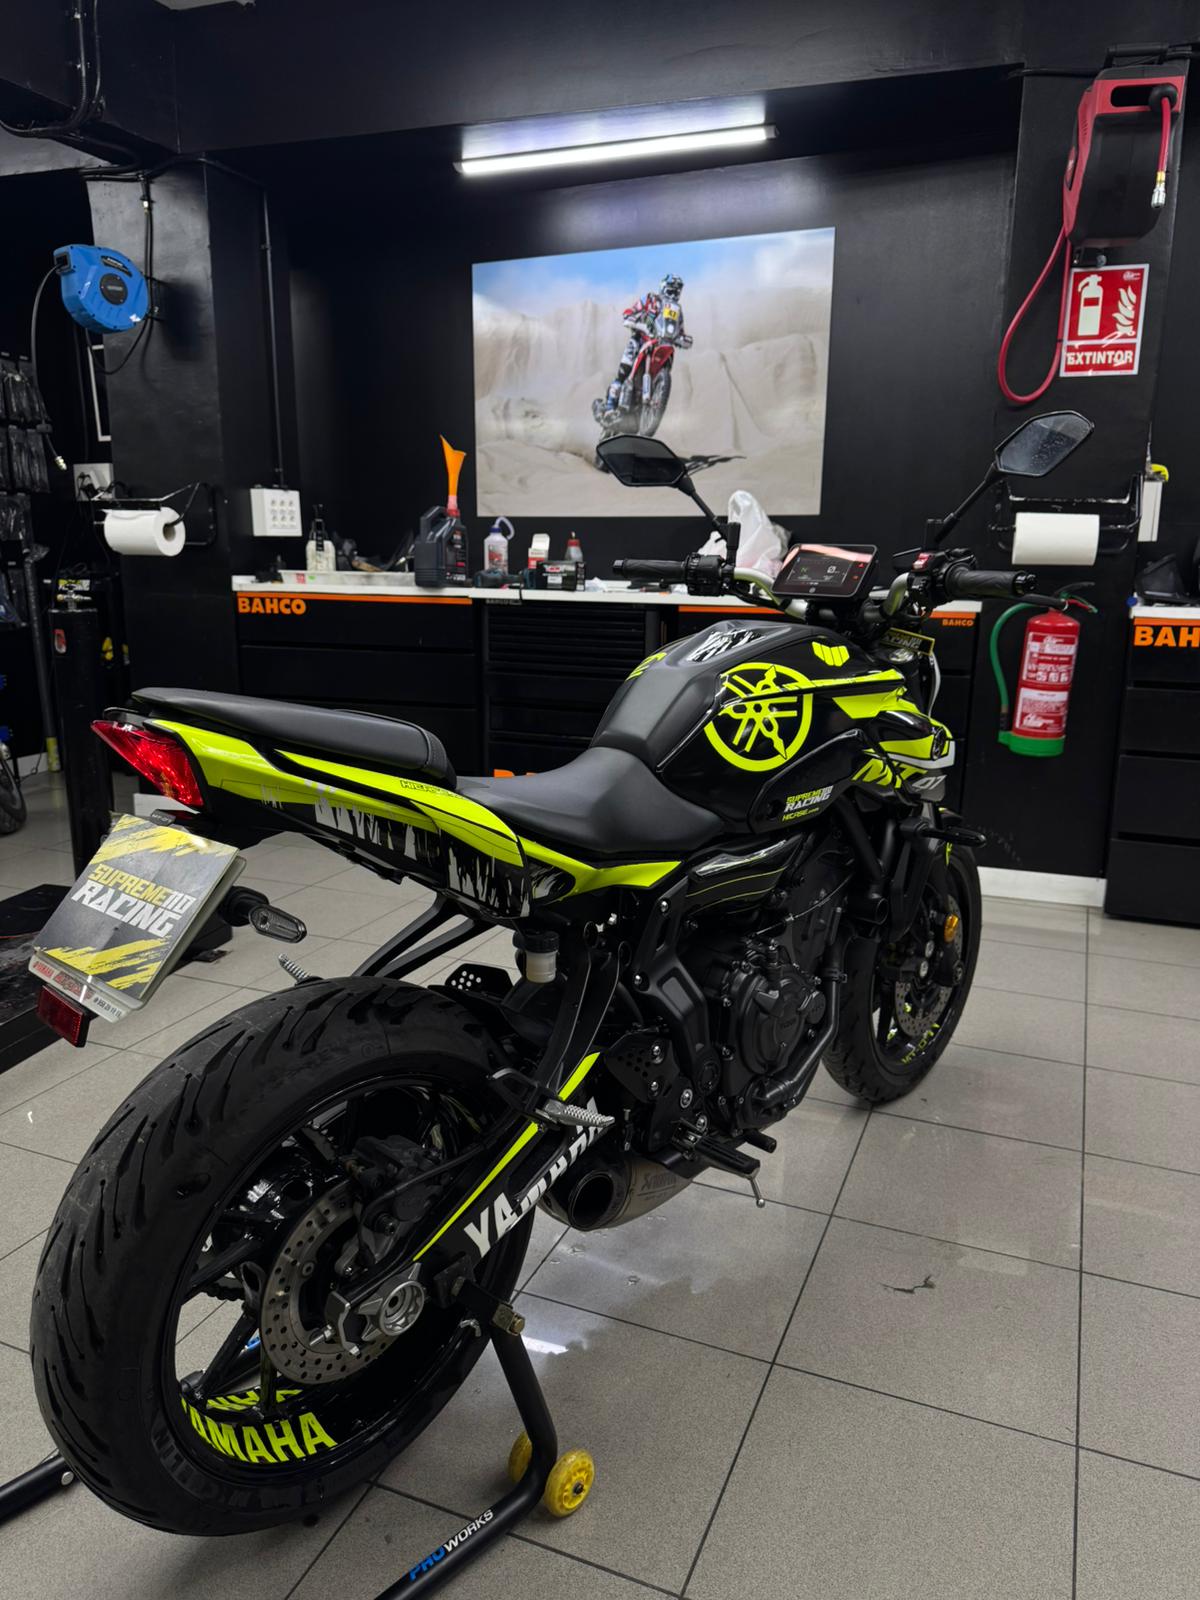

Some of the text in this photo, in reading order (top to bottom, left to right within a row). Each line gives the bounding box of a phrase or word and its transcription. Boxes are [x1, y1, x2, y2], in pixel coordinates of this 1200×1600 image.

[1066, 350, 1134, 366] EXTINTOR
[238, 598, 307, 615] BAHCO
[942, 619, 975, 627] BAHCO
[784, 793, 831, 813] RACING
[71, 880, 182, 938] RACING
